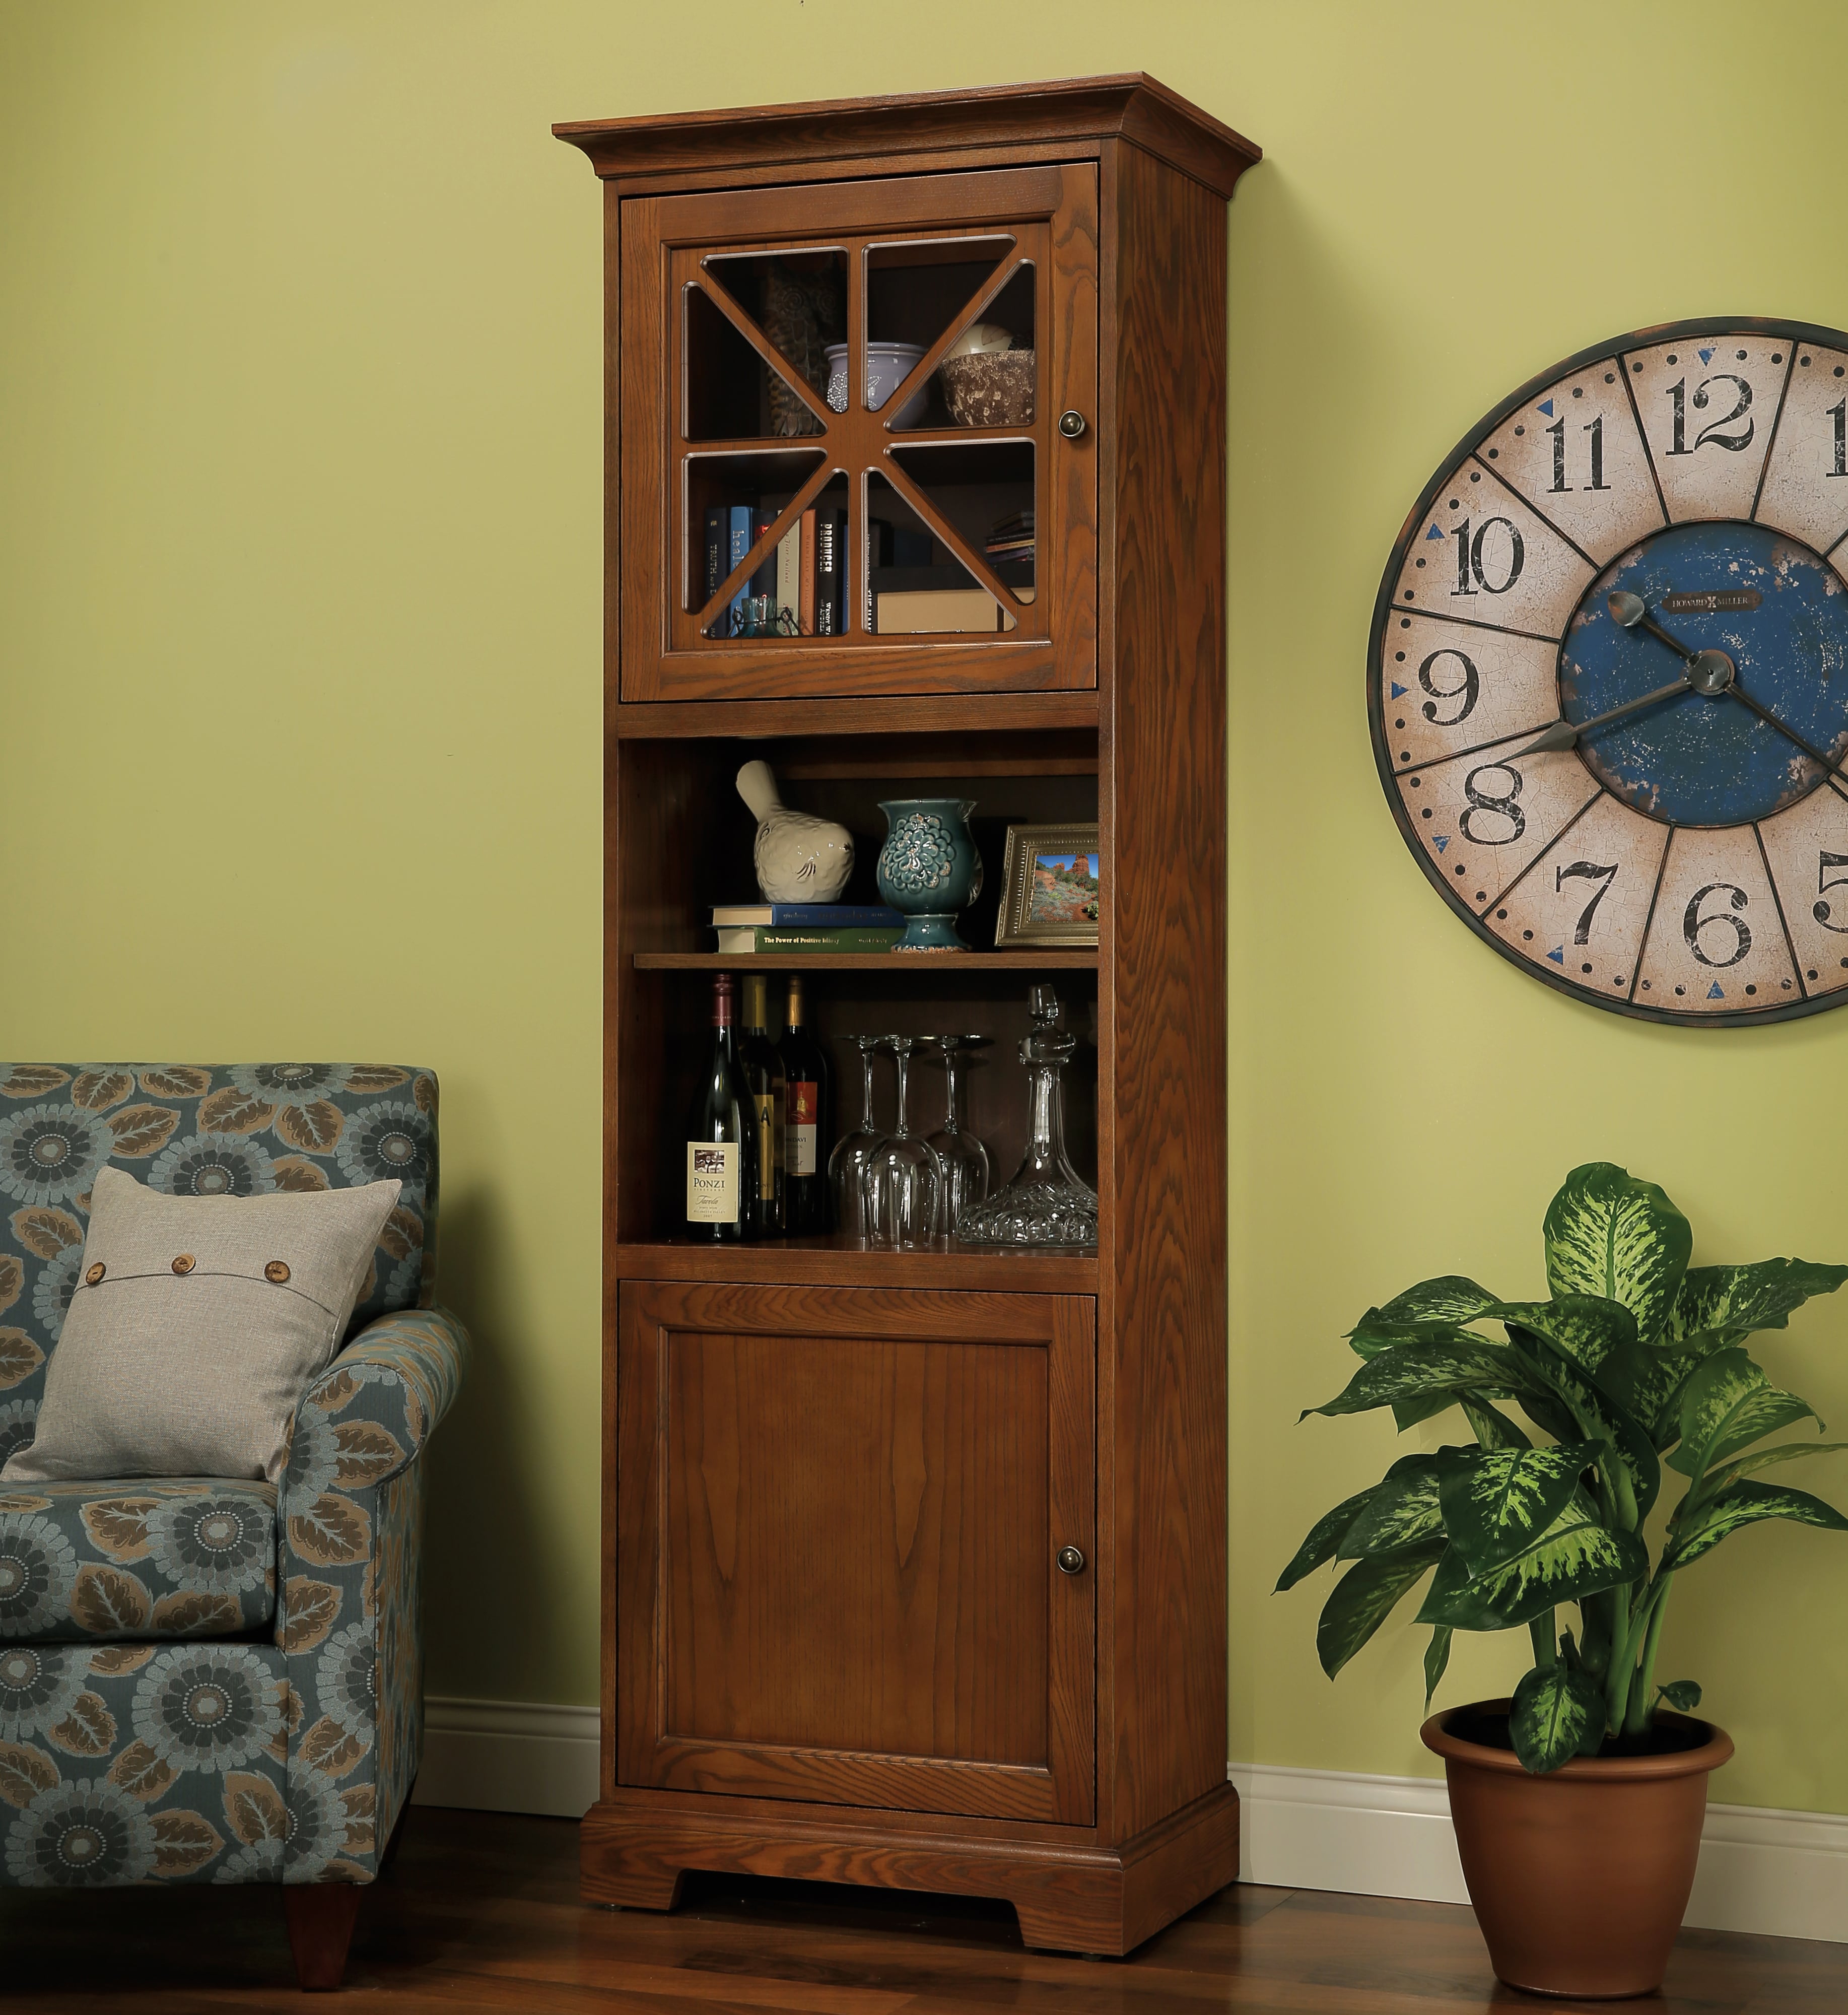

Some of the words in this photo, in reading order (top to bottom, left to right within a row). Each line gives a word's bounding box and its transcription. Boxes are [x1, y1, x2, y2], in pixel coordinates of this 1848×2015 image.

[1545, 413, 1612, 493] 11
[1665, 374, 1754, 455] 12
[1826, 396, 1848, 477] 1
[733, 530, 745, 568] heale
[819, 523, 833, 573] PRODUCER
[1450, 516, 1525, 596] 10
[1672, 599, 1707, 608] HOWARD
[1717, 597, 1748, 605] MILLER
[1418, 649, 1480, 726] 9
[1459, 763, 1526, 846] 8
[1556, 861, 1619, 946] 7
[1683, 883, 1752, 968] 6
[694, 1177, 725, 1188] PONZI
